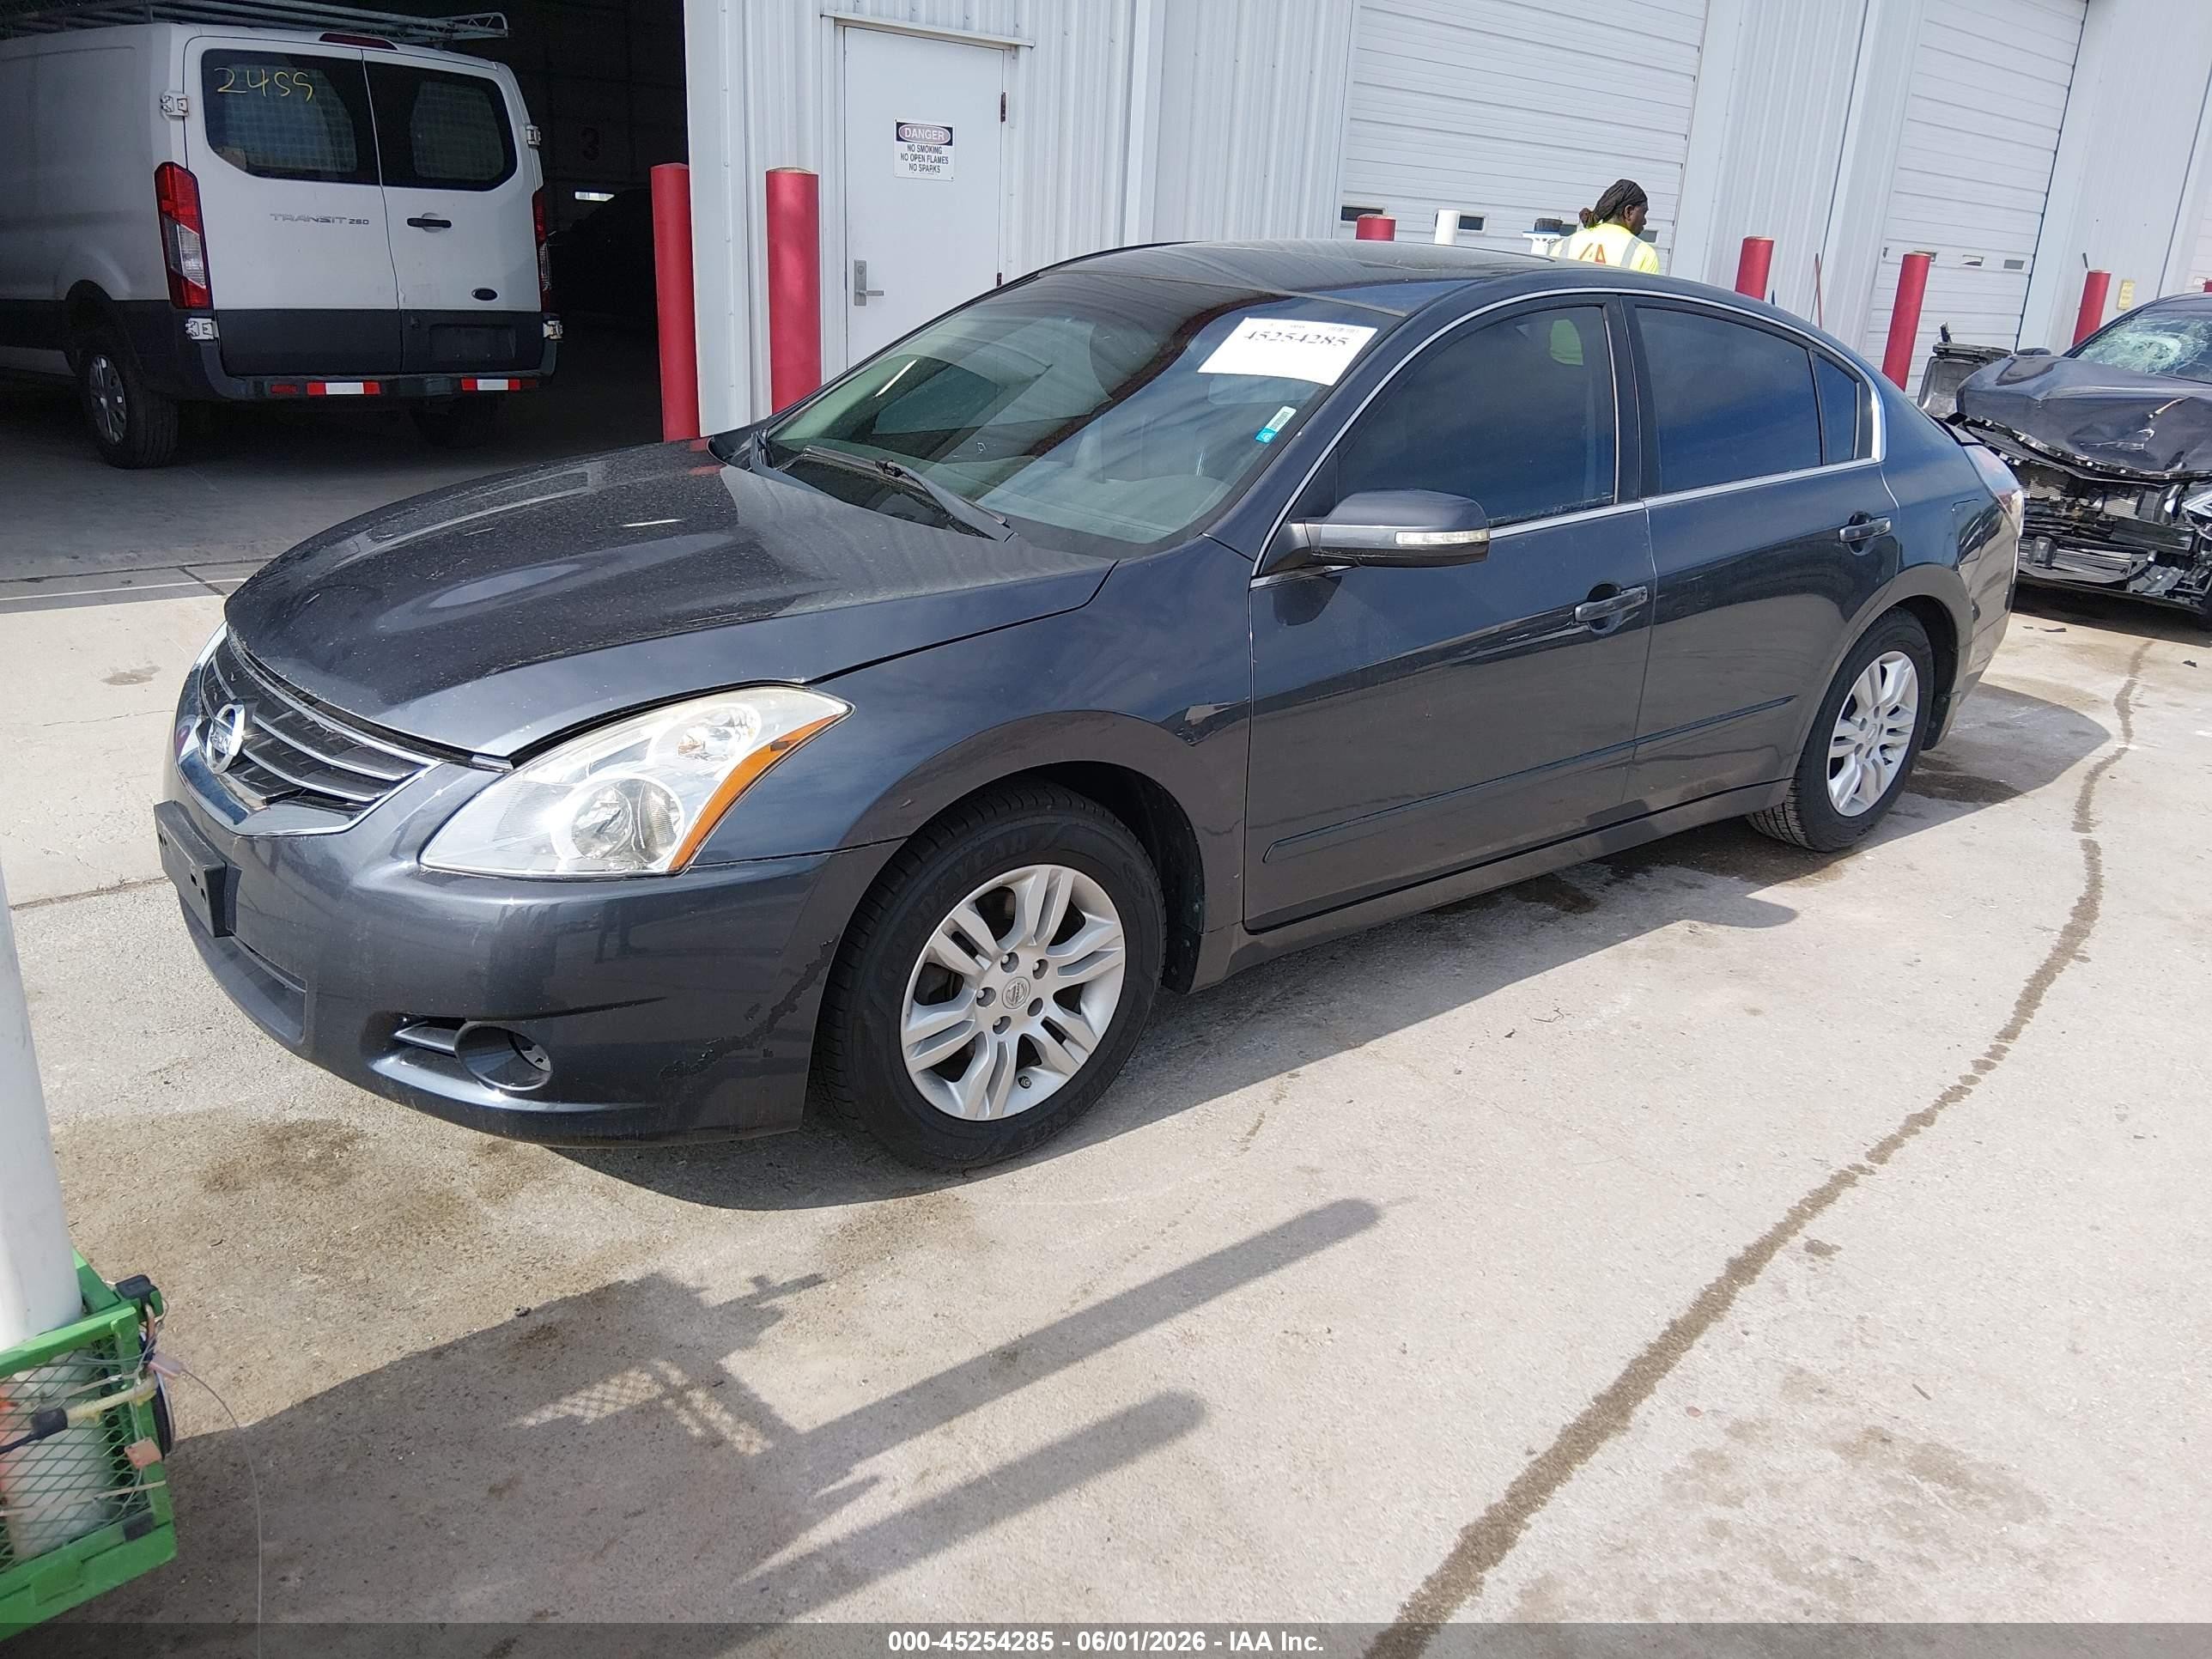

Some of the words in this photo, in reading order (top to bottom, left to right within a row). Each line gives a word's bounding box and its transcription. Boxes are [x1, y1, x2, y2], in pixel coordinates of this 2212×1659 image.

[904, 127, 945, 141] DANGER
[907, 143, 916, 152] NO
[916, 144, 943, 155] SMOKING
[900, 152, 909, 161] NO
[910, 153, 926, 162] OPEN
[927, 155, 949, 164] FLAMES
[908, 163, 918, 172] NO
[918, 163, 941, 173] SPARKS
[270, 213, 347, 224] TRANSIT
[1243, 331, 1350, 346] 45254285
